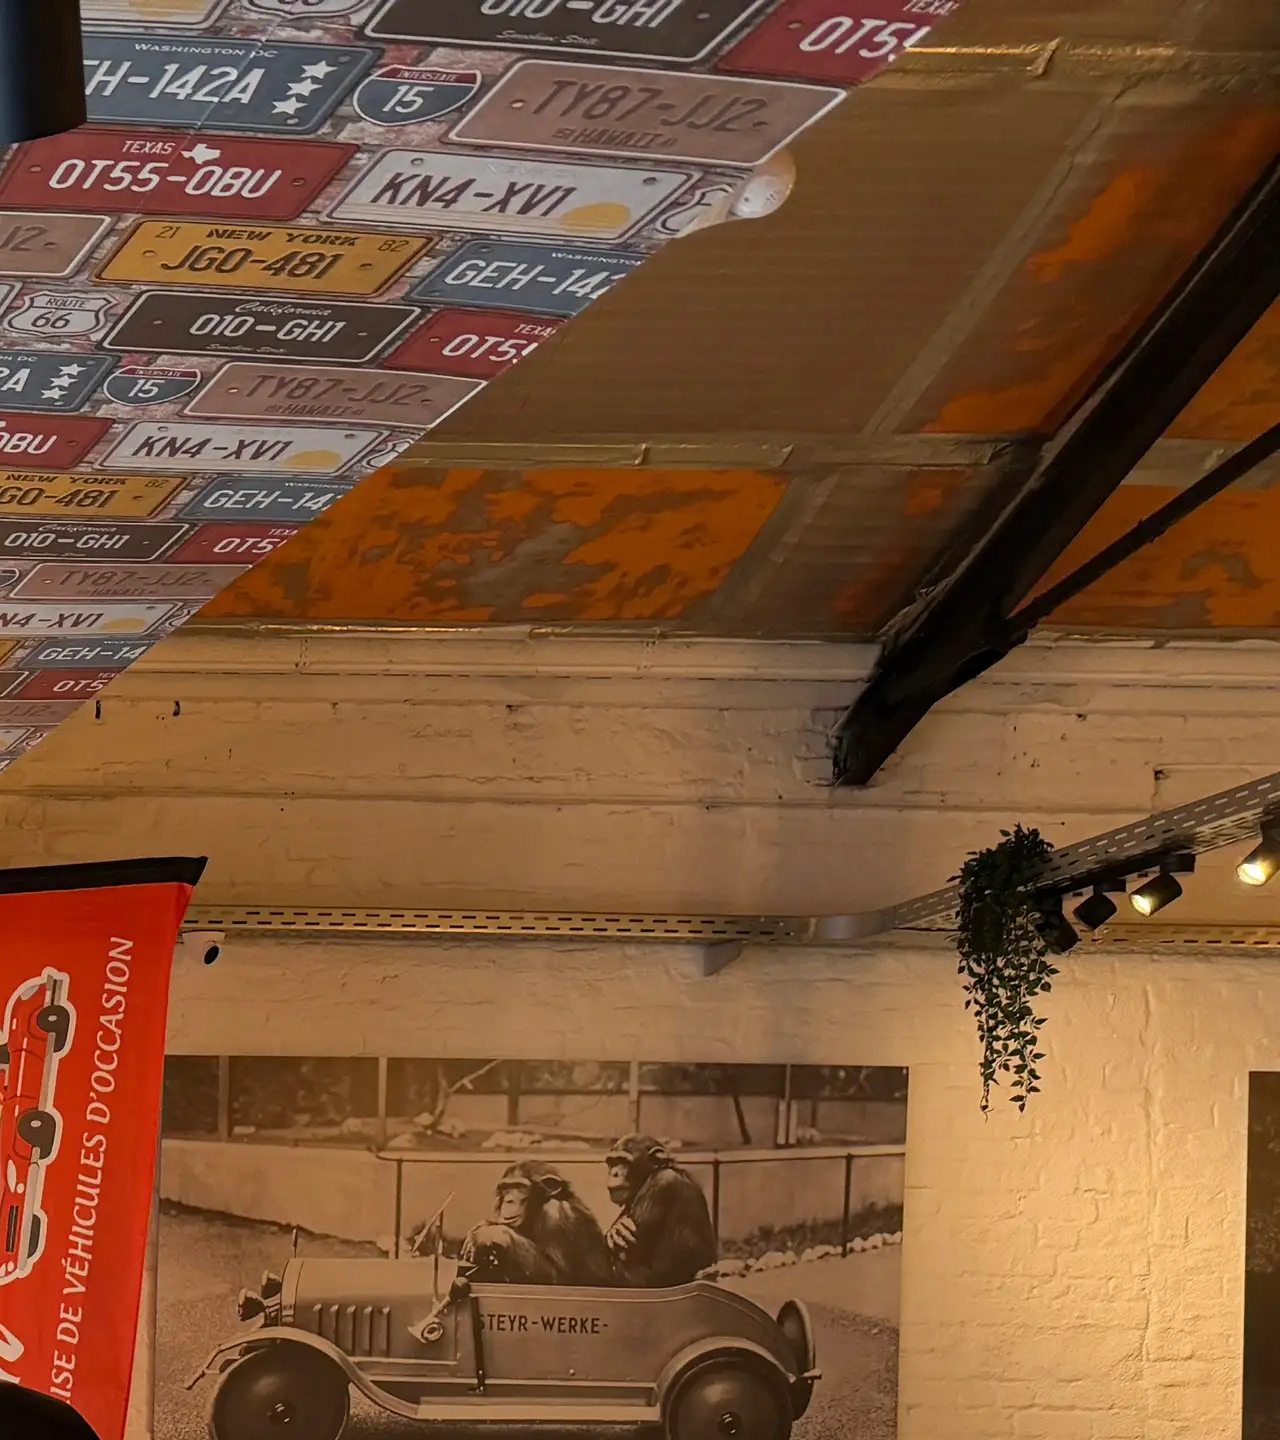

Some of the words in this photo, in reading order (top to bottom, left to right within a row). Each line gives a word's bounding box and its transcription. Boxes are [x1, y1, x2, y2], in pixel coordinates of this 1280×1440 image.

[382, 84, 435, 113] 15
[121, 139, 176, 155] TEXAS
[153, 224, 182, 239] 21
[204, 227, 275, 242] NEW
[285, 231, 362, 247] YORK
[376, 237, 411, 253] 82
[233, 301, 333, 316] California
[85, 936, 134, 1125] D'OCCASION
[60, 1130, 108, 1298] VÉHICULES
[57, 1303, 83, 1345] DE
